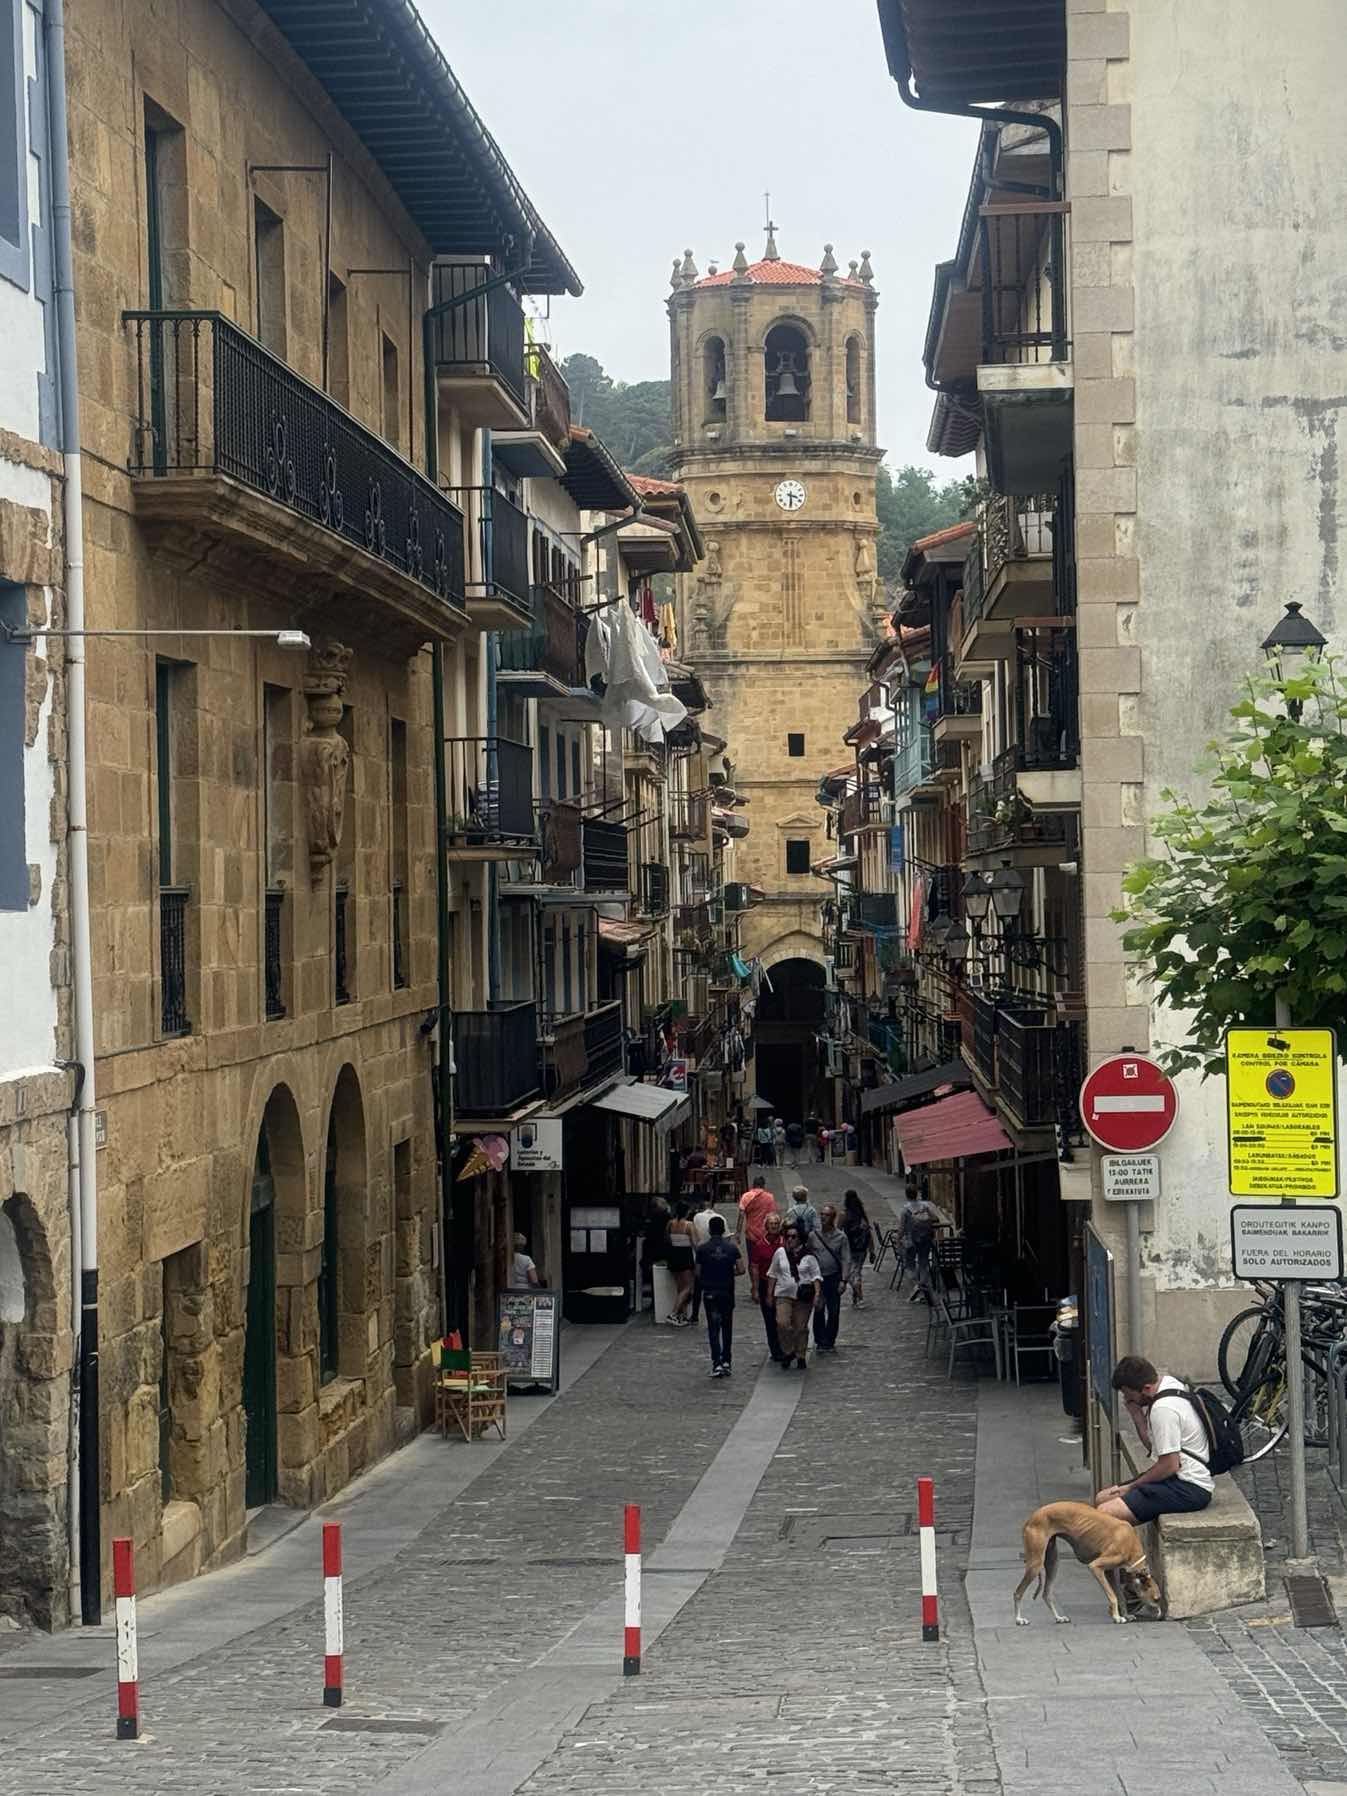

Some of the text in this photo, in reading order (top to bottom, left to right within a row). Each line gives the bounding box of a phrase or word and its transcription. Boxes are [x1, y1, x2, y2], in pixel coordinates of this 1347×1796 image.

[1301, 1221, 1330, 1229] KANPO
[1241, 1249, 1269, 1257] FUERA
[1272, 1249, 1289, 1257] DEL
[1271, 1258, 1331, 1266] AUTORIZADOS
